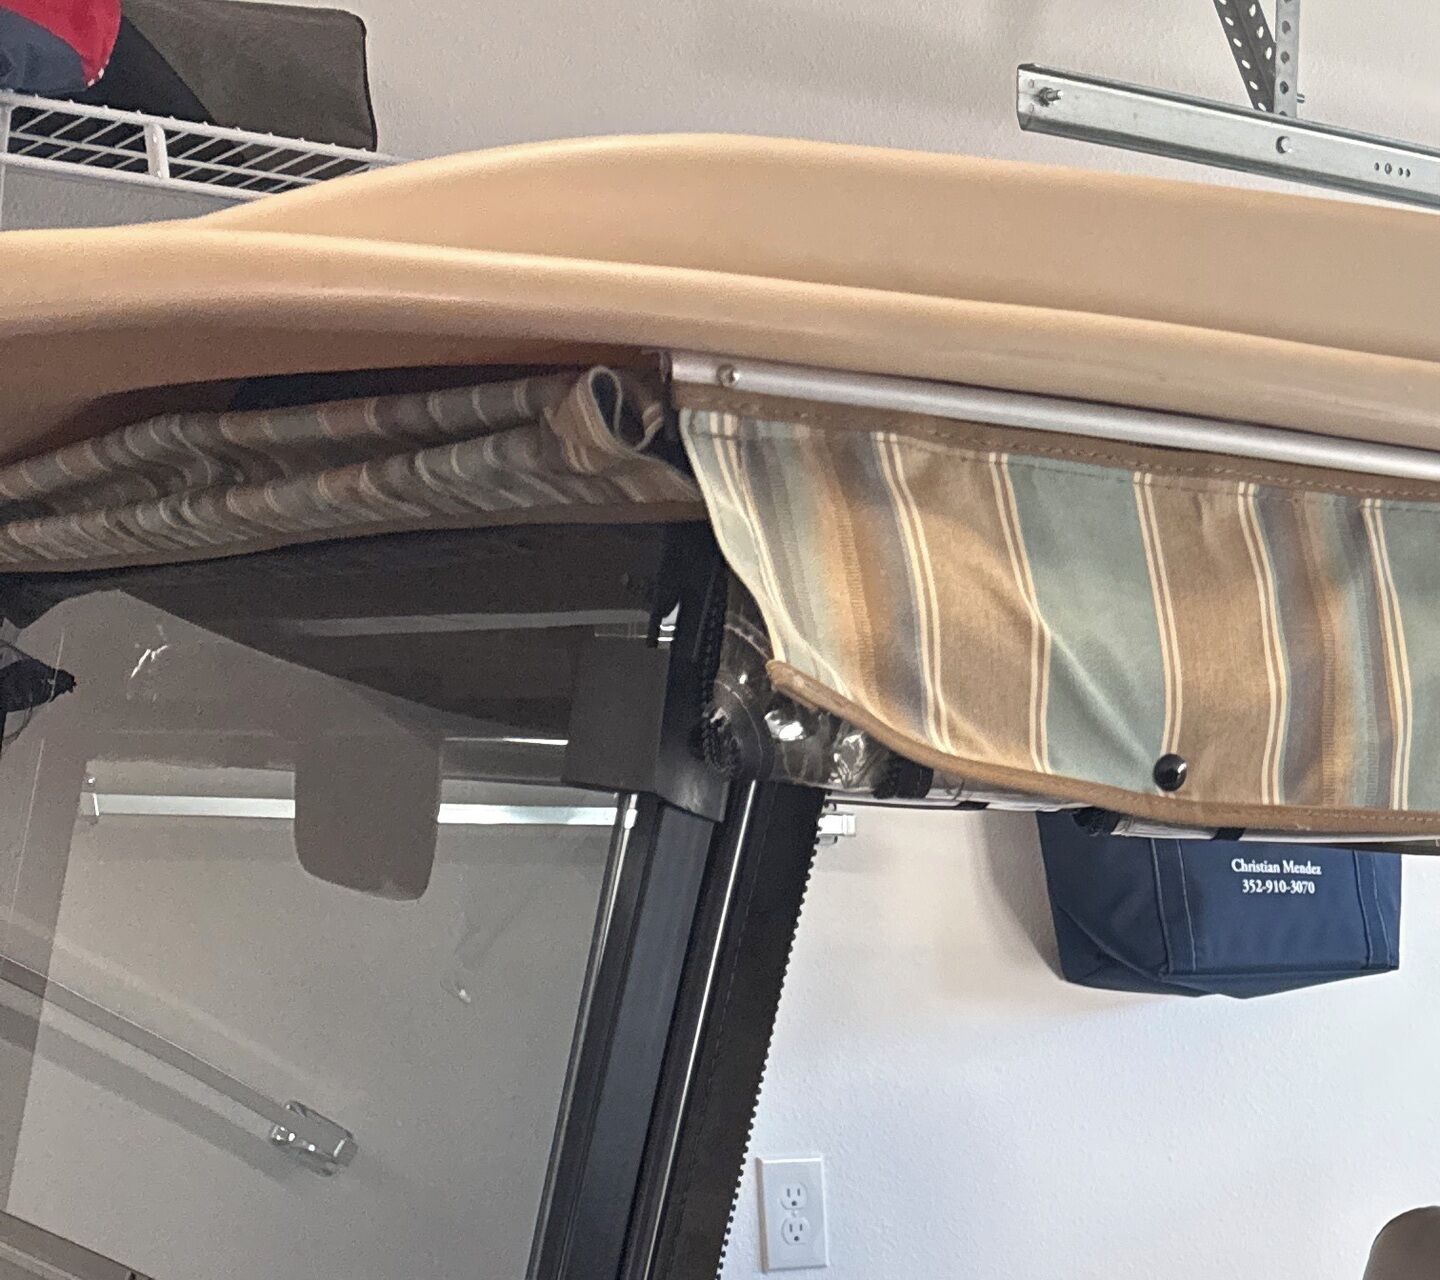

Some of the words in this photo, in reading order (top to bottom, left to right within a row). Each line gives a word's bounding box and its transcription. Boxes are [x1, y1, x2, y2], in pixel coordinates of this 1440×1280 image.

[1231, 858, 1280, 873] Christian
[1283, 860, 1322, 875] Mendez
[1242, 879, 1316, 895] 352-910-3070
